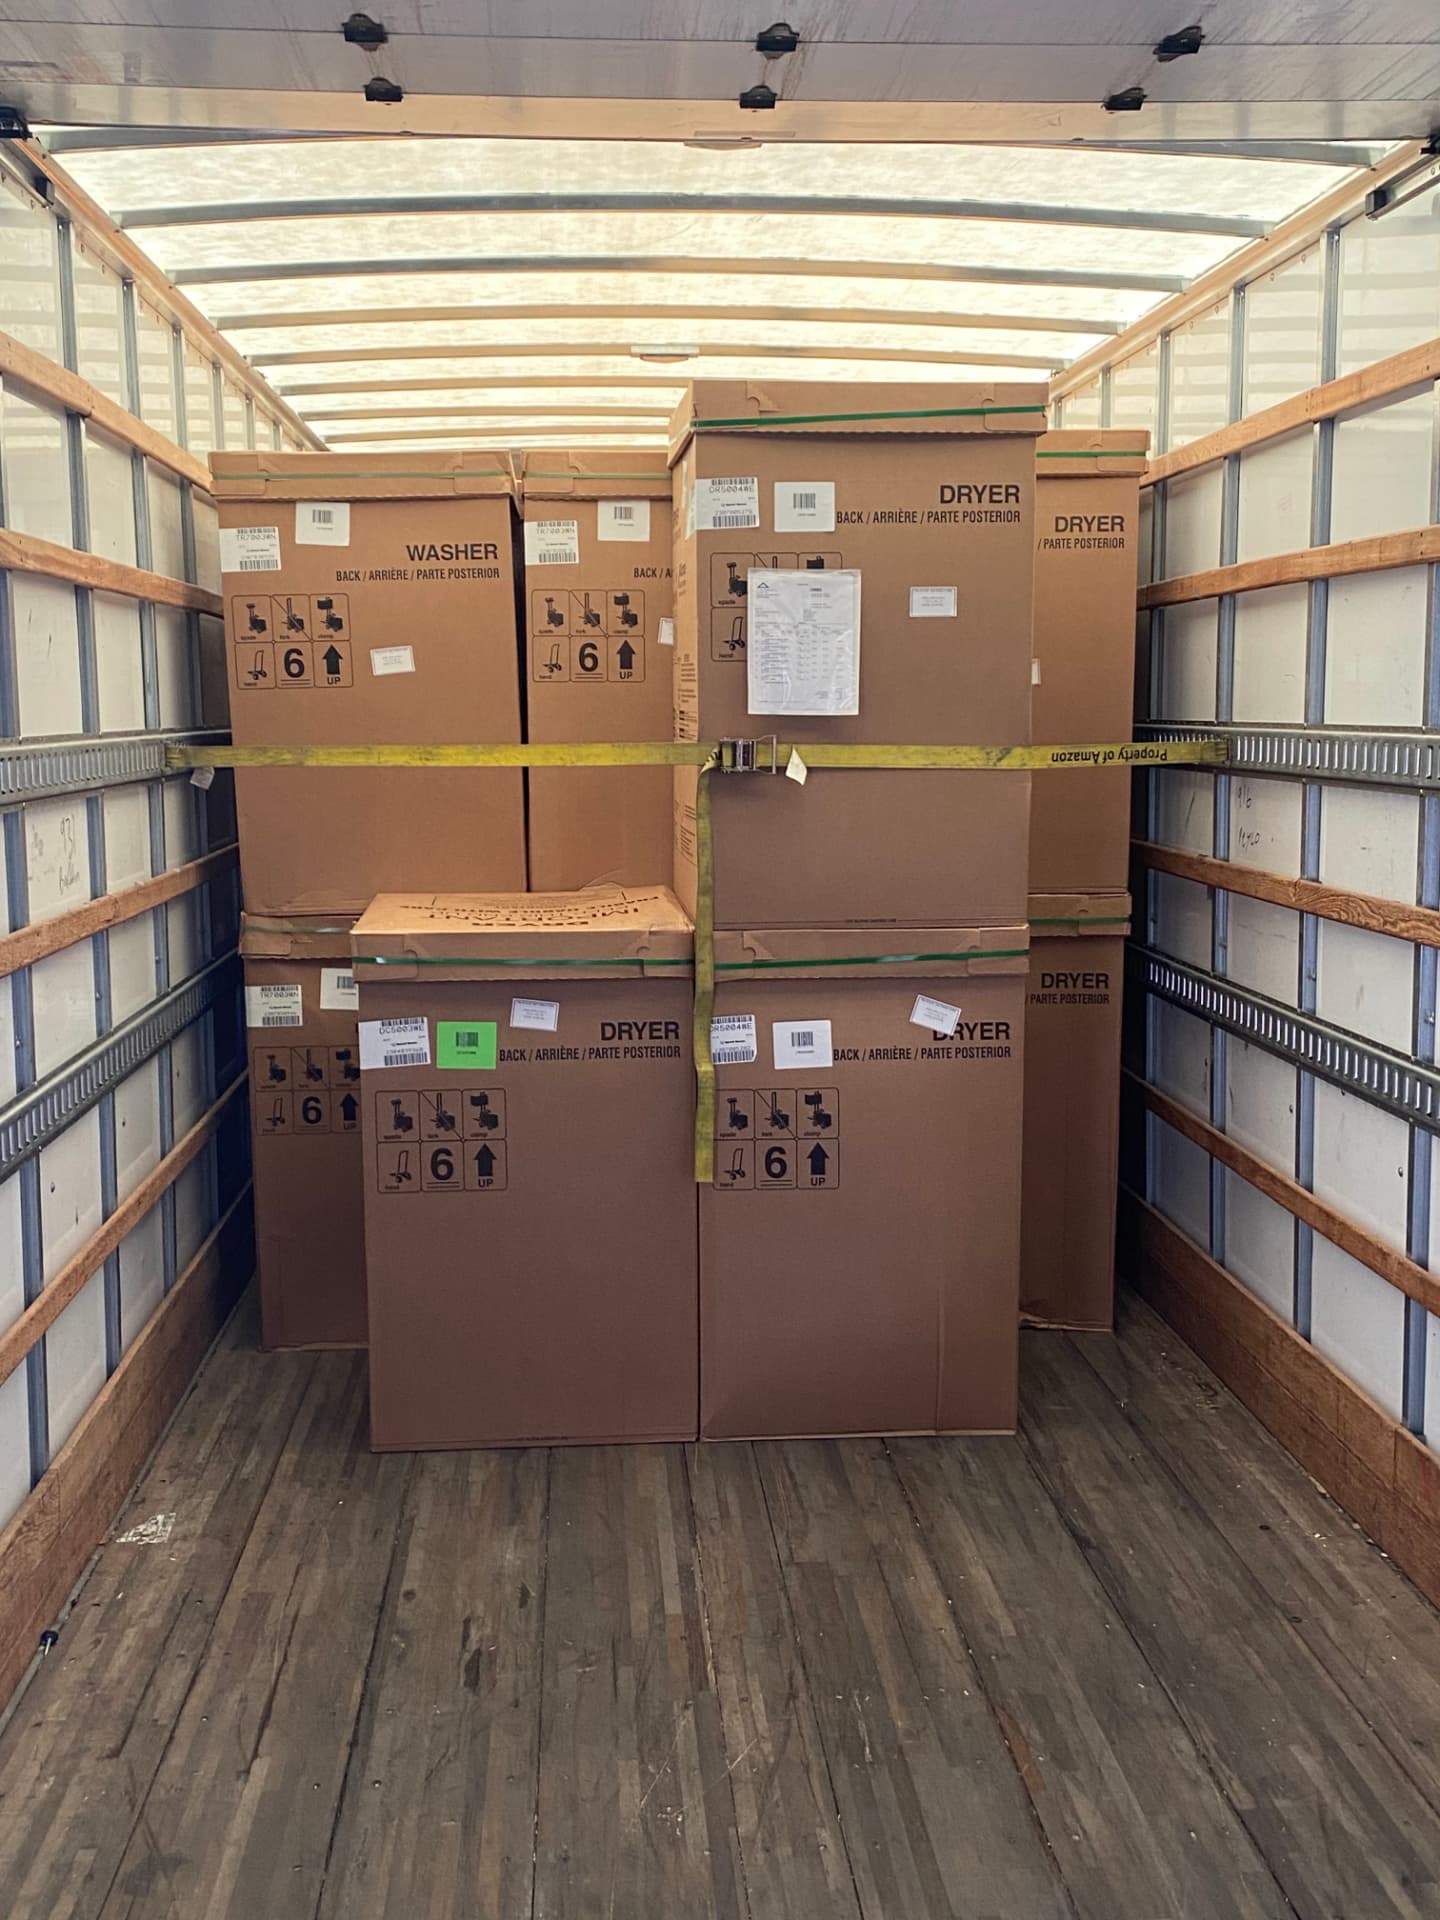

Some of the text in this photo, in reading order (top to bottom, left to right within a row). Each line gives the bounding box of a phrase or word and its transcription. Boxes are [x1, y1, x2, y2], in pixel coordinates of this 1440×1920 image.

[939, 484, 1020, 504] DRYER
[836, 511, 863, 524] BACK
[872, 508, 917, 523] ARRIÈRE
[927, 510, 959, 523] PARTE
[962, 510, 1021, 523] POSTERIOR
[1055, 515, 1125, 533] DRYER
[406, 543, 499, 561] WASHER
[1043, 538, 1072, 550] PARTE
[1074, 537, 1125, 549] POSTERIOR
[336, 570, 361, 582] BACK
[368, 567, 408, 581] ARRIÈRE
[416, 569, 446, 580] PARTE
[448, 567, 500, 579] POSTERIOR
[633, 567, 657, 578] BACK
[284, 648, 305, 678] 6
[578, 642, 599, 672] 6
[327, 677, 341, 685] UP
[619, 671, 633, 680] UP
[1051, 746, 1168, 764] Property of Amazon
[1041, 972, 1109, 989] DRYER
[1030, 993, 1057, 1005] PARTE
[1060, 993, 1110, 1005] POSTERIOR
[600, 1021, 680, 1041] DRYER
[499, 1049, 526, 1062] BACK
[535, 1045, 579, 1060] ARRIÈRE
[588, 1047, 620, 1059] PARTE
[623, 1046, 681, 1059] POSTERIOR
[833, 1049, 860, 1061] BACK
[868, 1045, 912, 1060] ARRIÈRE
[920, 1047, 953, 1059] PARTE
[955, 1046, 1012, 1059] POSTERIOR
[302, 1095, 322, 1125] 6
[343, 1122, 357, 1130] UP
[431, 1147, 454, 1181] 6
[764, 1146, 787, 1179] 6
[478, 1178, 494, 1188] UP
[810, 1177, 826, 1186] UP
